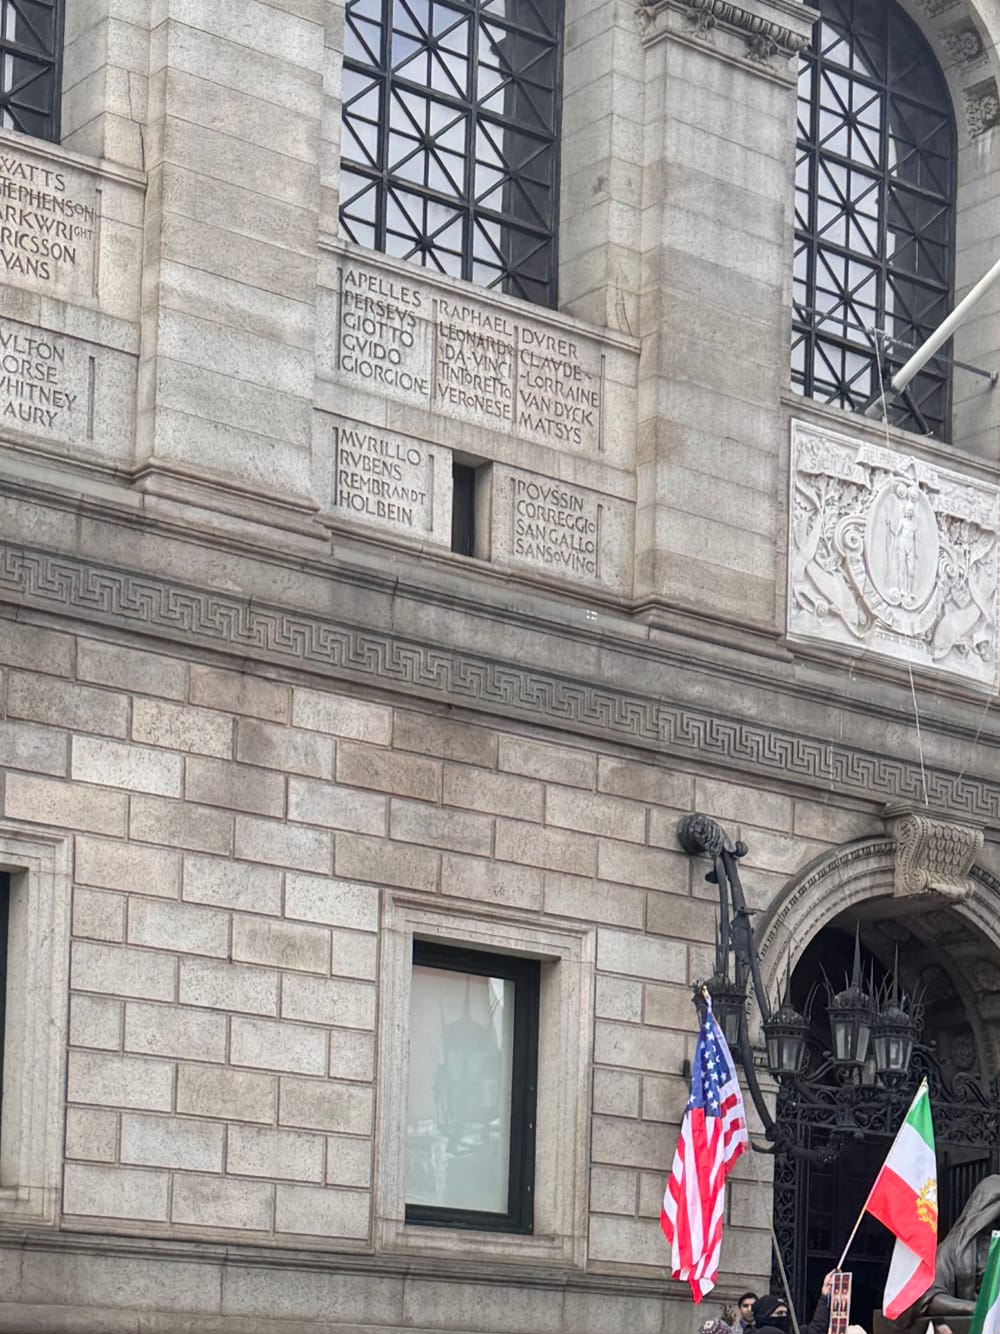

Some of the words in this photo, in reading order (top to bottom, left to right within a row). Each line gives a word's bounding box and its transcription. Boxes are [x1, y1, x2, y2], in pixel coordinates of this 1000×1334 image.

[0, 155, 65, 192] WATTS
[0, 227, 77, 265] RICSSON
[0, 249, 50, 280] VANS
[345, 270, 421, 307] APELLES
[342, 312, 414, 347] GIOTTO
[440, 299, 512, 336] RAPHAEL
[0, 333, 64, 362] VLTON
[342, 334, 401, 365] GVIDO
[522, 327, 578, 359] DVRER
[0, 355, 58, 385] ORSE
[341, 355, 429, 396] GIORGIONE
[439, 361, 512, 399] TINTORETTO
[3, 402, 58, 427] AURY
[438, 382, 511, 420] VERONESE
[519, 389, 550, 412] VAN
[554, 400, 594, 427] DYCK
[519, 412, 582, 444] MATSYS
[340, 428, 421, 466] MVRILLO
[340, 449, 402, 481] RVBENS
[339, 469, 426, 505] REMBRANDT
[516, 478, 584, 512] POVSSIN
[339, 490, 413, 527] HOLBEIN
[516, 500, 596, 533] CORREGGIO
[515, 519, 546, 539] SAN
[549, 529, 595, 554] GALLO
